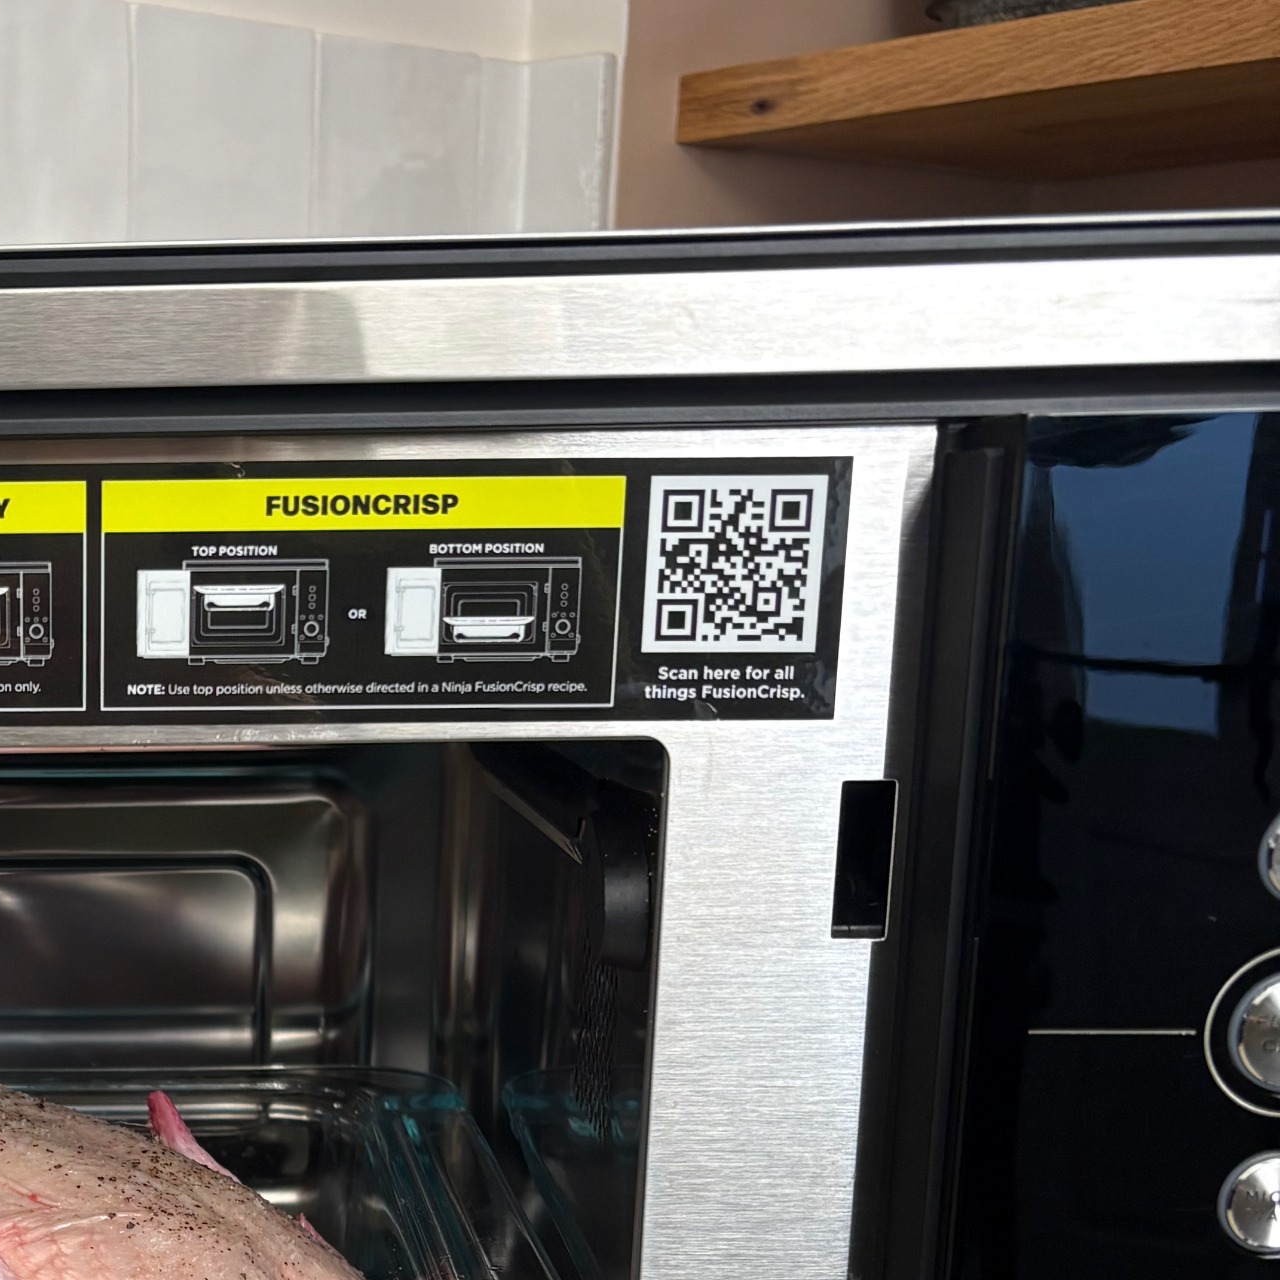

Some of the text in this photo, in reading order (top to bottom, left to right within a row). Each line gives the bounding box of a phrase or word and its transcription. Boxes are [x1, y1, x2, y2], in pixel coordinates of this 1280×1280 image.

[265, 493, 458, 516] FUSIONCRISP
[191, 545, 277, 556] TOP POSITION
[429, 542, 544, 554] BOTTOM POSITION
[347, 608, 366, 619] OR
[657, 665, 794, 680] Scan here for all
[14, 680, 41, 694] only.
[126, 680, 587, 696] NOTE: Use top position unless otherwise directed in a Ninja FusionCrisp recipe.
[644, 684, 805, 701] things FusionCrisp.
